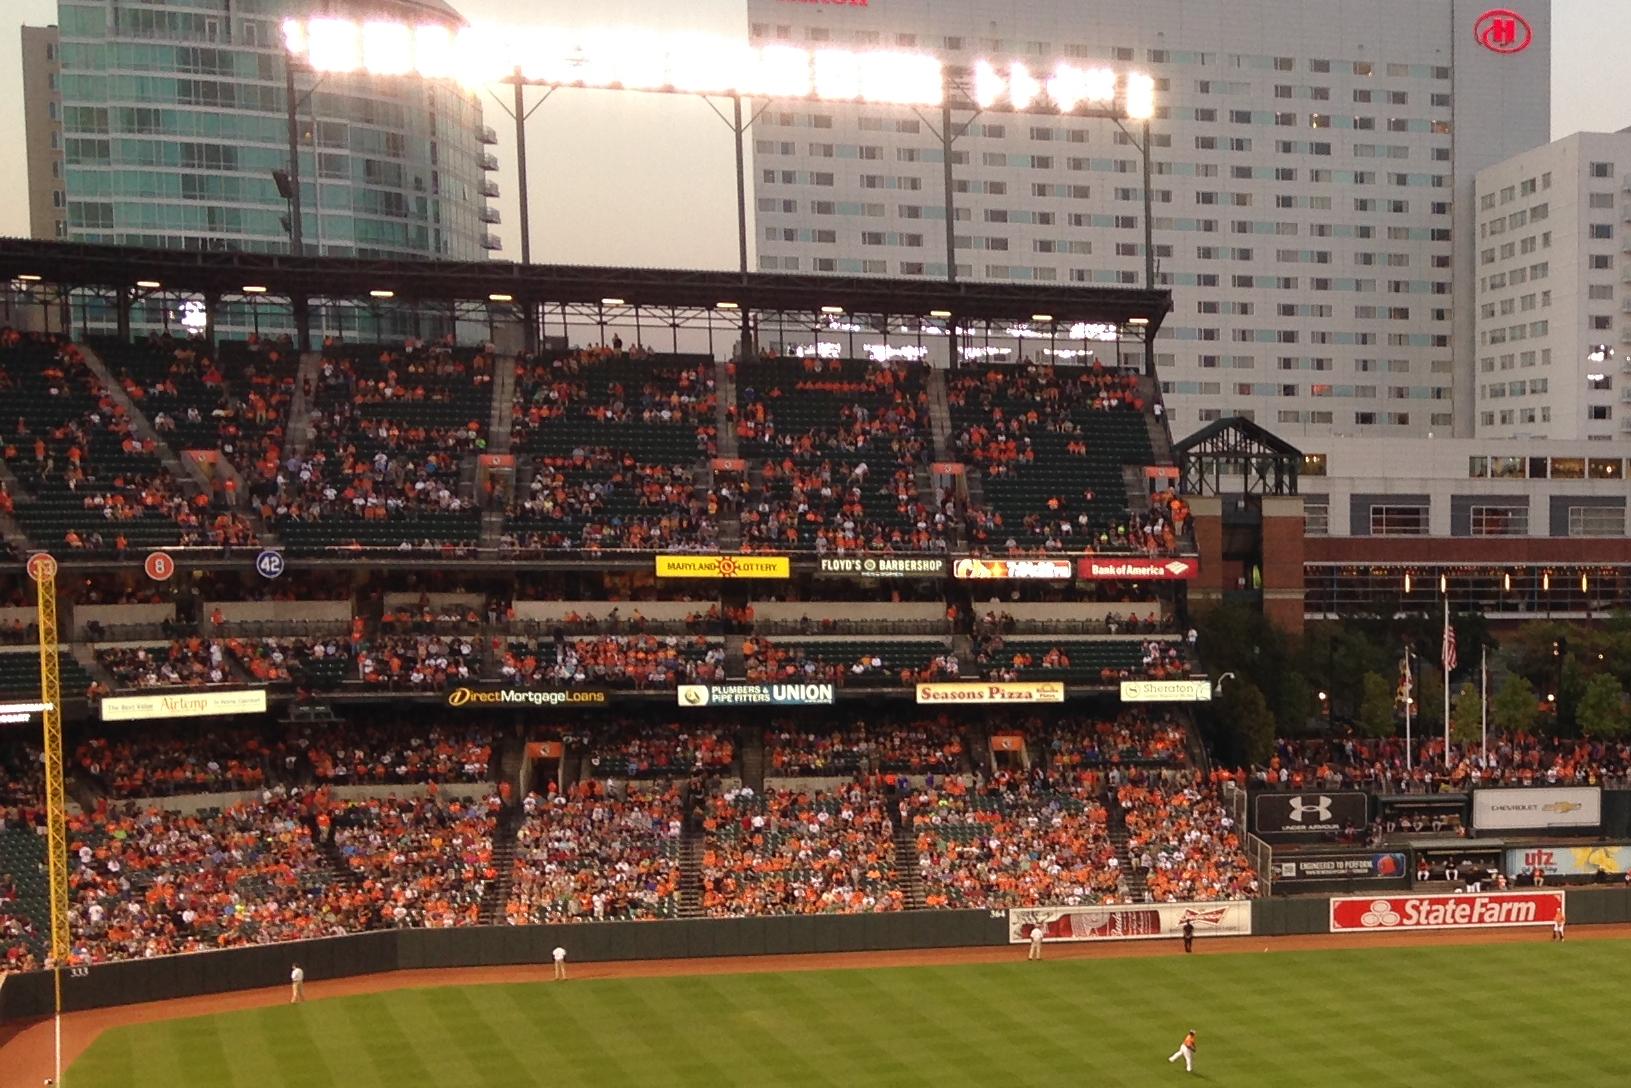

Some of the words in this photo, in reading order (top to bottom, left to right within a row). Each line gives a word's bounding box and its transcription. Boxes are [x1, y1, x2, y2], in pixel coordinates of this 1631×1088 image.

[154, 559, 165, 573] 8
[261, 557, 281, 572] 42
[667, 561, 716, 571] MARYLAND
[738, 563, 778, 573] LOTTERY
[821, 559, 862, 571] FLOYD'S
[879, 559, 943, 572] BARBERSHOP
[711, 685, 761, 695] PLUMBERS
[772, 684, 834, 701] UNION
[921, 687, 984, 700] Seasons
[988, 686, 1033, 700] Pizza
[1143, 683, 1194, 694] Sheraton
[711, 694, 733, 703] PIPE
[734, 693, 771, 703] FITTERS
